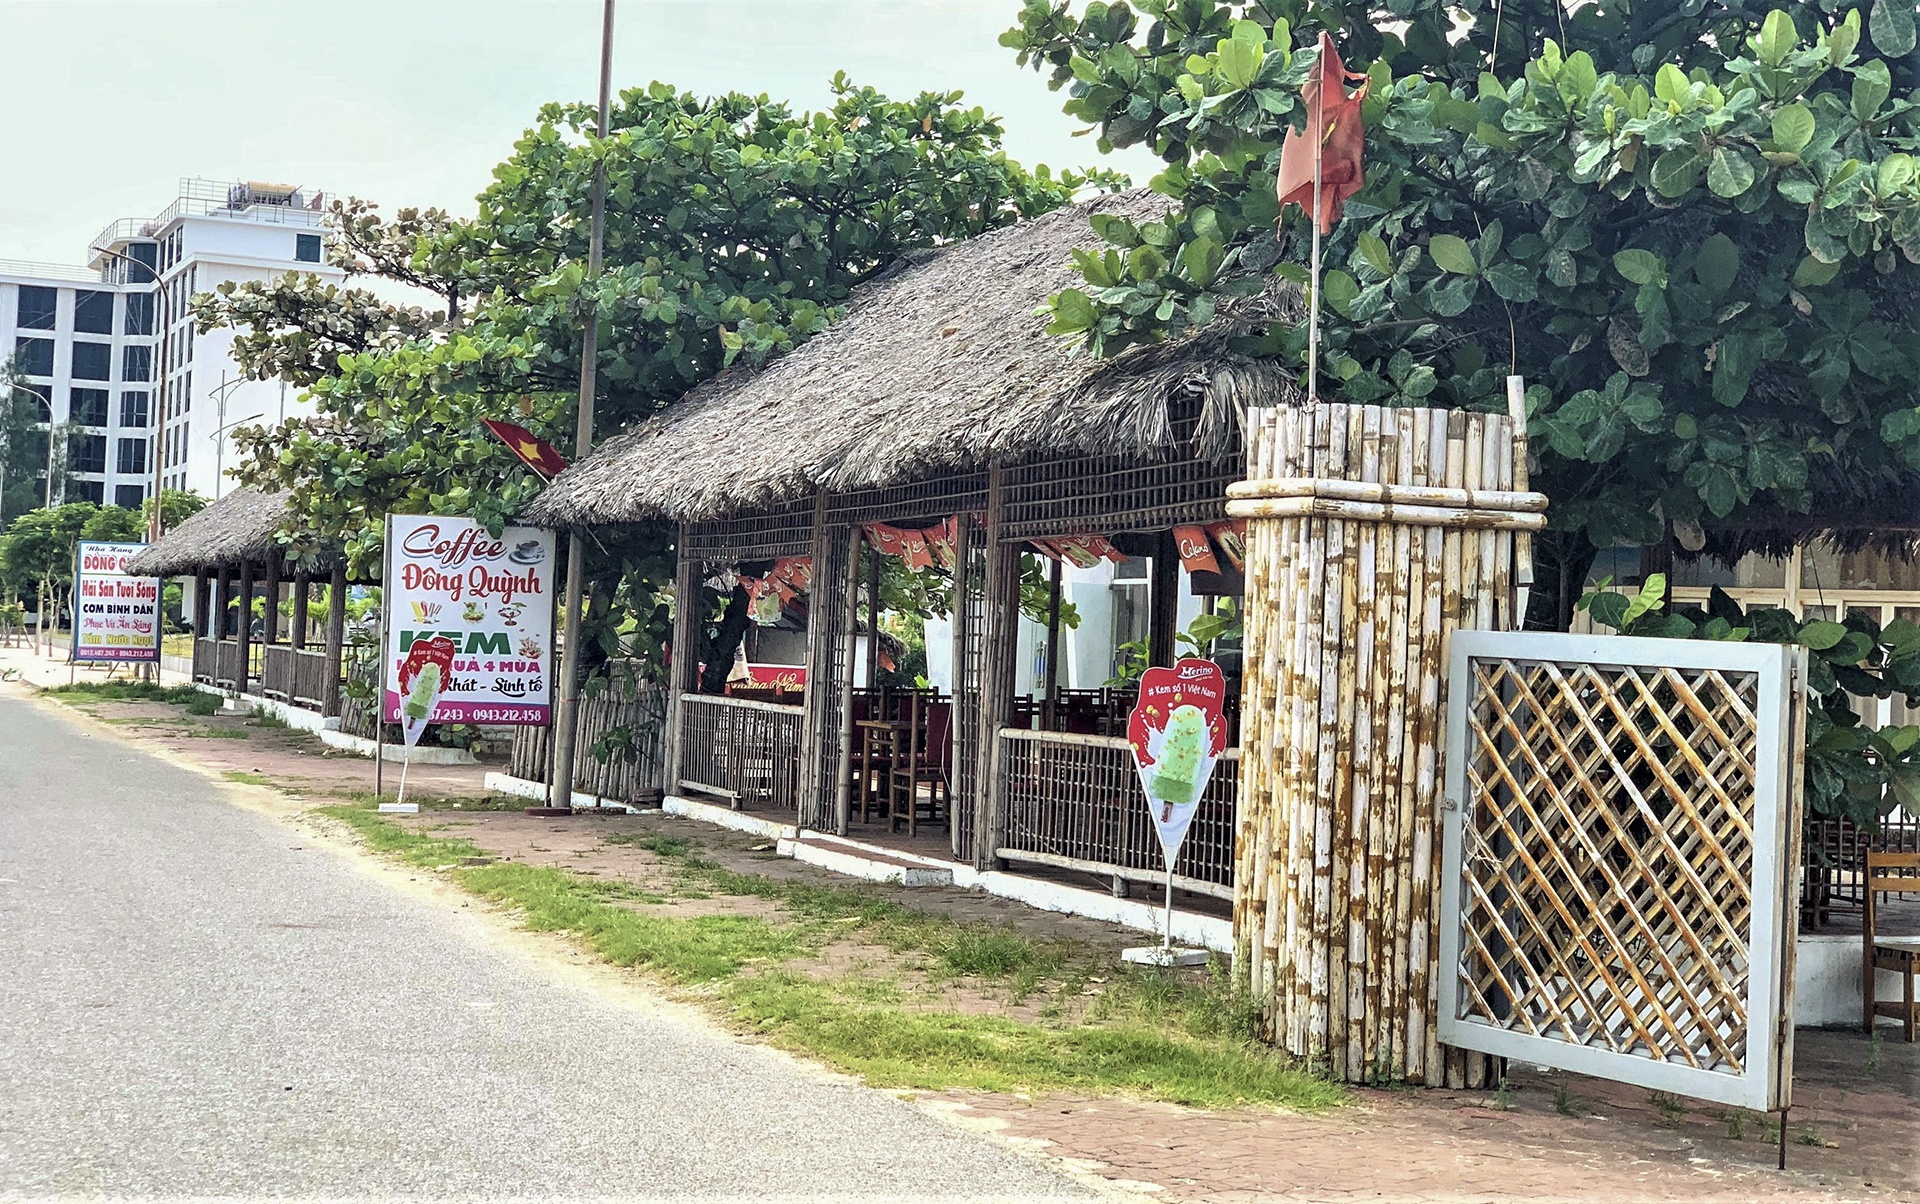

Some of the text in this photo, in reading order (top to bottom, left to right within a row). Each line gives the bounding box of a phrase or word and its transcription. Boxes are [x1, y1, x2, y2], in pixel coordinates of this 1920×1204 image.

[402, 524, 507, 567] Coffee
[401, 563, 543, 604] Đông Quỳnh
[449, 657, 541, 673] UẢ 4 MÙA
[1180, 665, 1214, 677] Merino
[490, 677, 527, 698] Sinh
[528, 675, 543, 692] tố
[1155, 684, 1171, 696] Kem
[1172, 682, 1180, 693] số
[1182, 683, 1186, 693] 1
[1187, 683, 1201, 696] Việt
[1200, 687, 1217, 699] Nam
[472, 708, 542, 722] 0943.212.458
